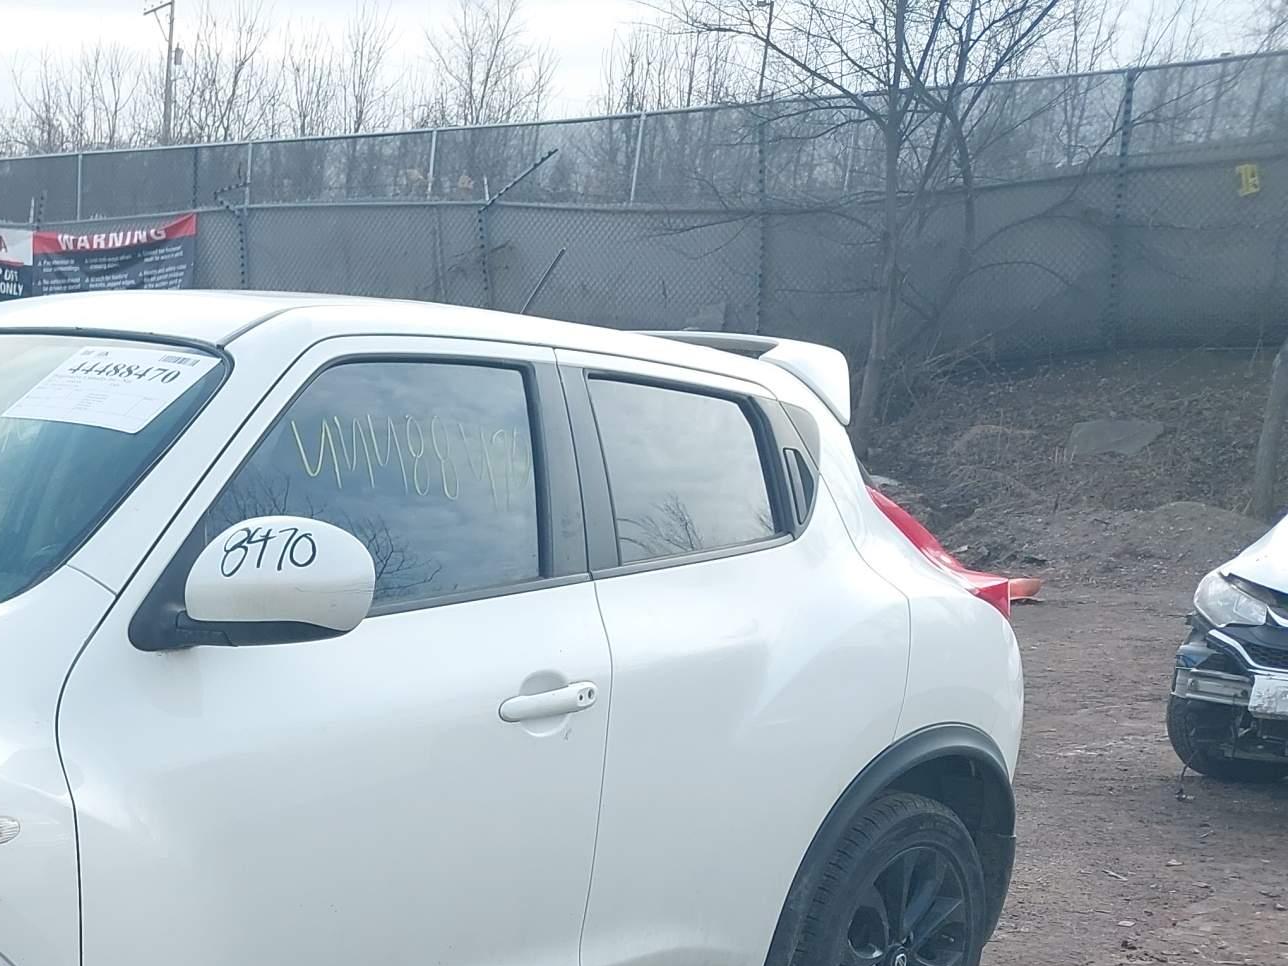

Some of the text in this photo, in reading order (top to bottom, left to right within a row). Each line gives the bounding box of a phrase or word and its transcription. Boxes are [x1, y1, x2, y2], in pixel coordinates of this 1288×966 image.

[57, 228, 167, 251] WARNING
[0, 282, 24, 296] ONLY
[68, 361, 181, 384] 44488470
[220, 527, 317, 577] 8470
